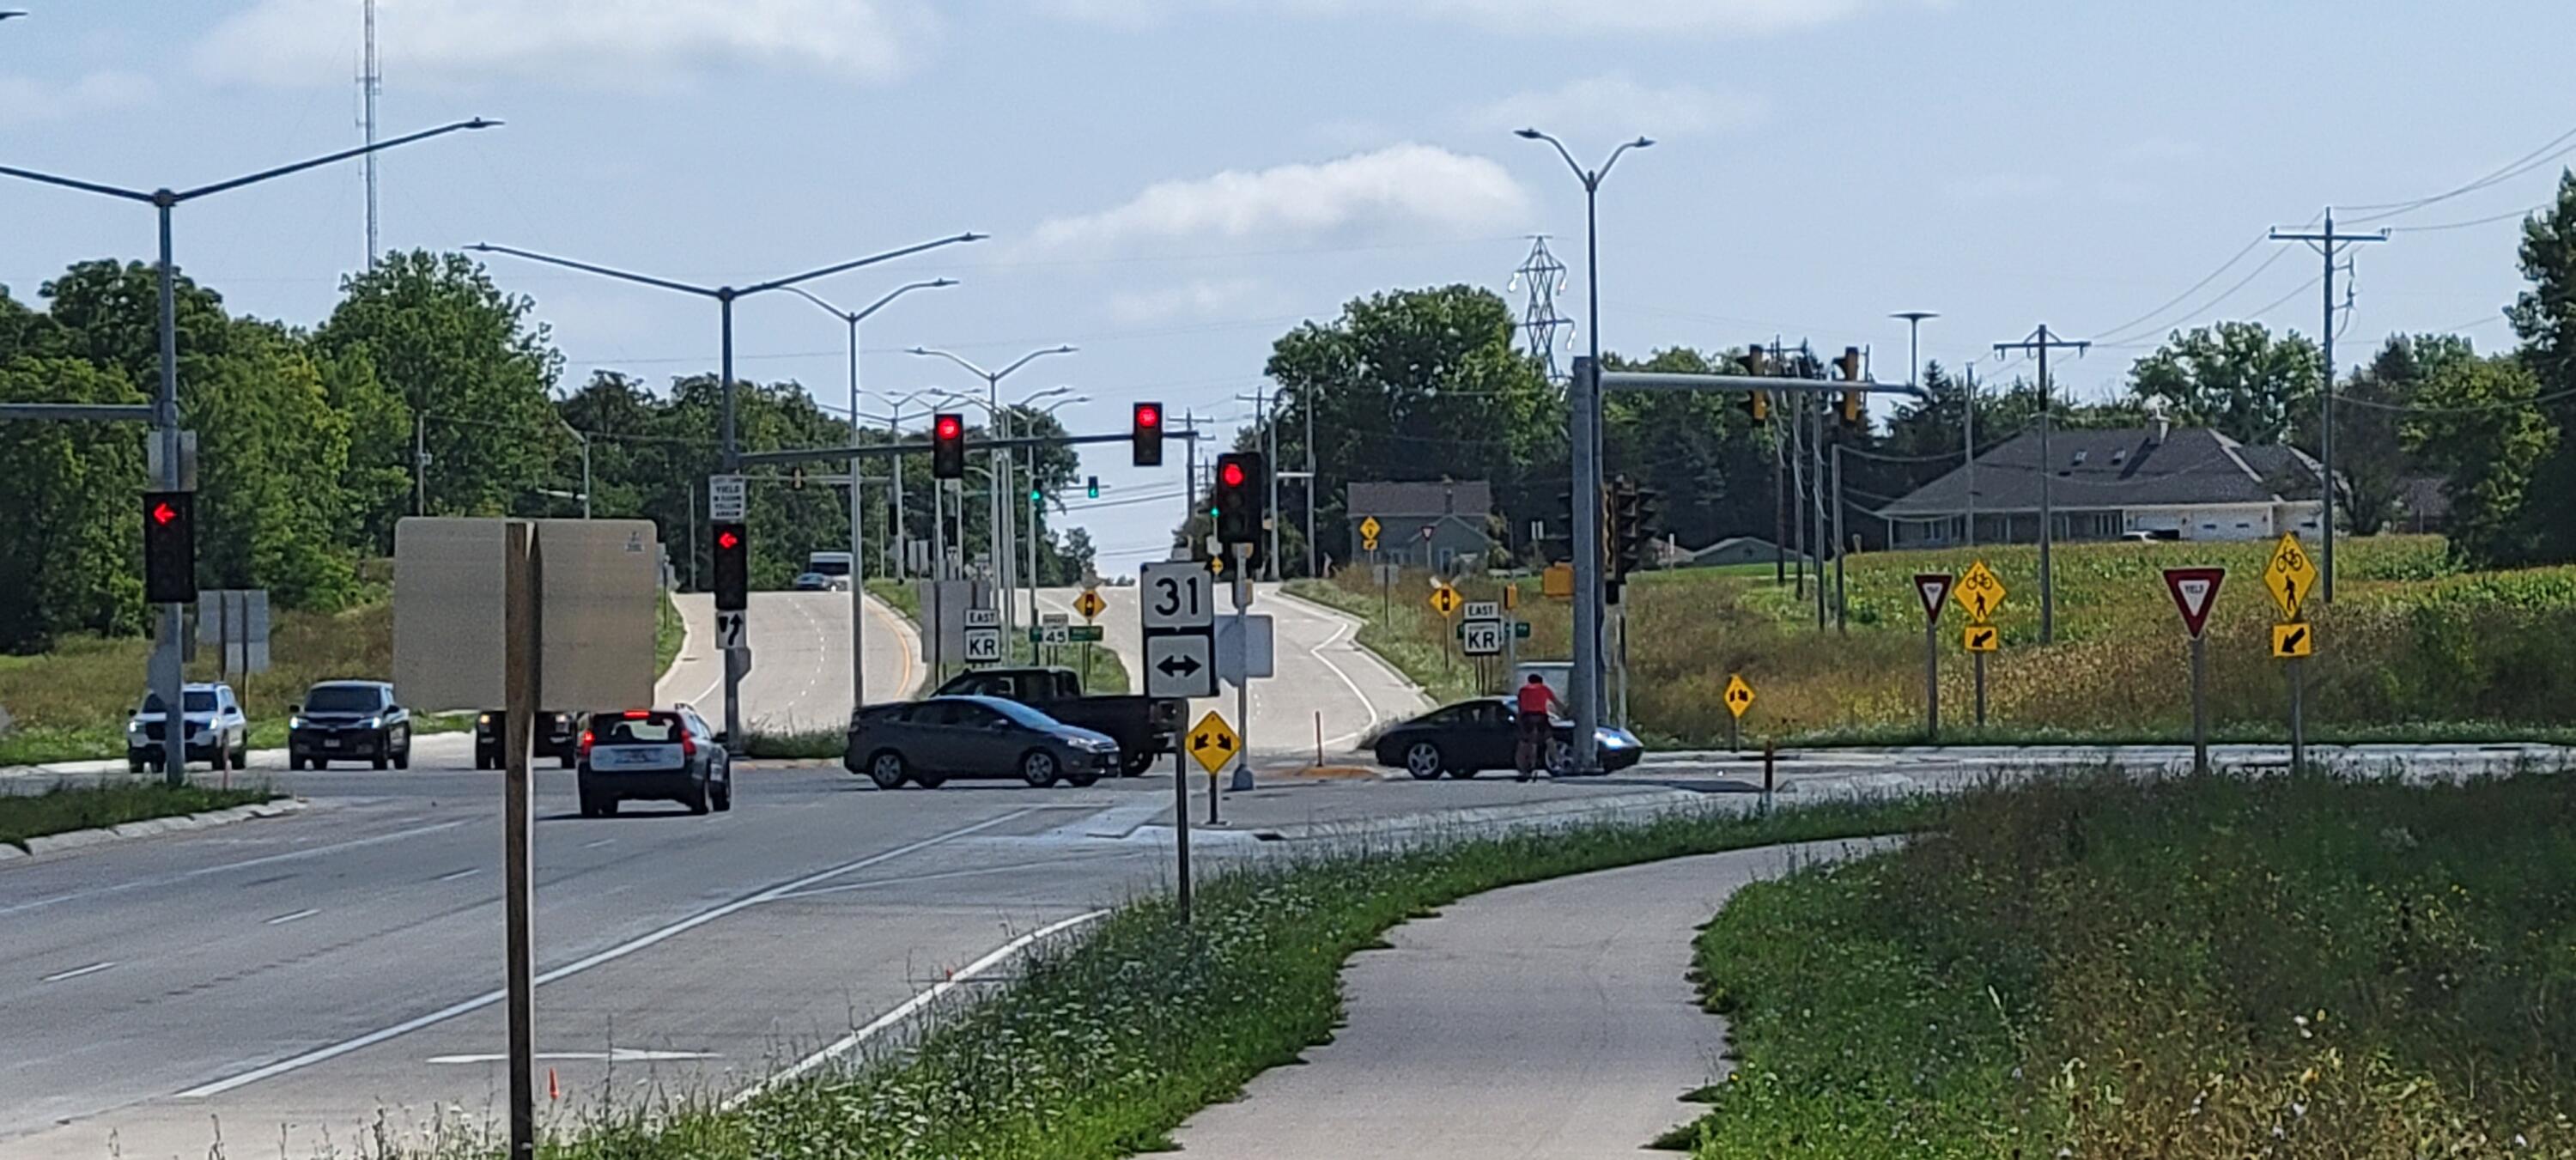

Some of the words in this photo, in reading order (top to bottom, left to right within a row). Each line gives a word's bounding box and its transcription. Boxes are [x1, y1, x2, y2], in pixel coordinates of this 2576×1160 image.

[2184, 585, 2204, 594] YIELD
[1155, 577, 1198, 616] 31
[1468, 604, 1493, 616] EAST
[969, 612, 995, 623] EAST
[1046, 631, 1066, 643] 45
[1468, 631, 1495, 649] KR
[969, 638, 996, 655] KR
